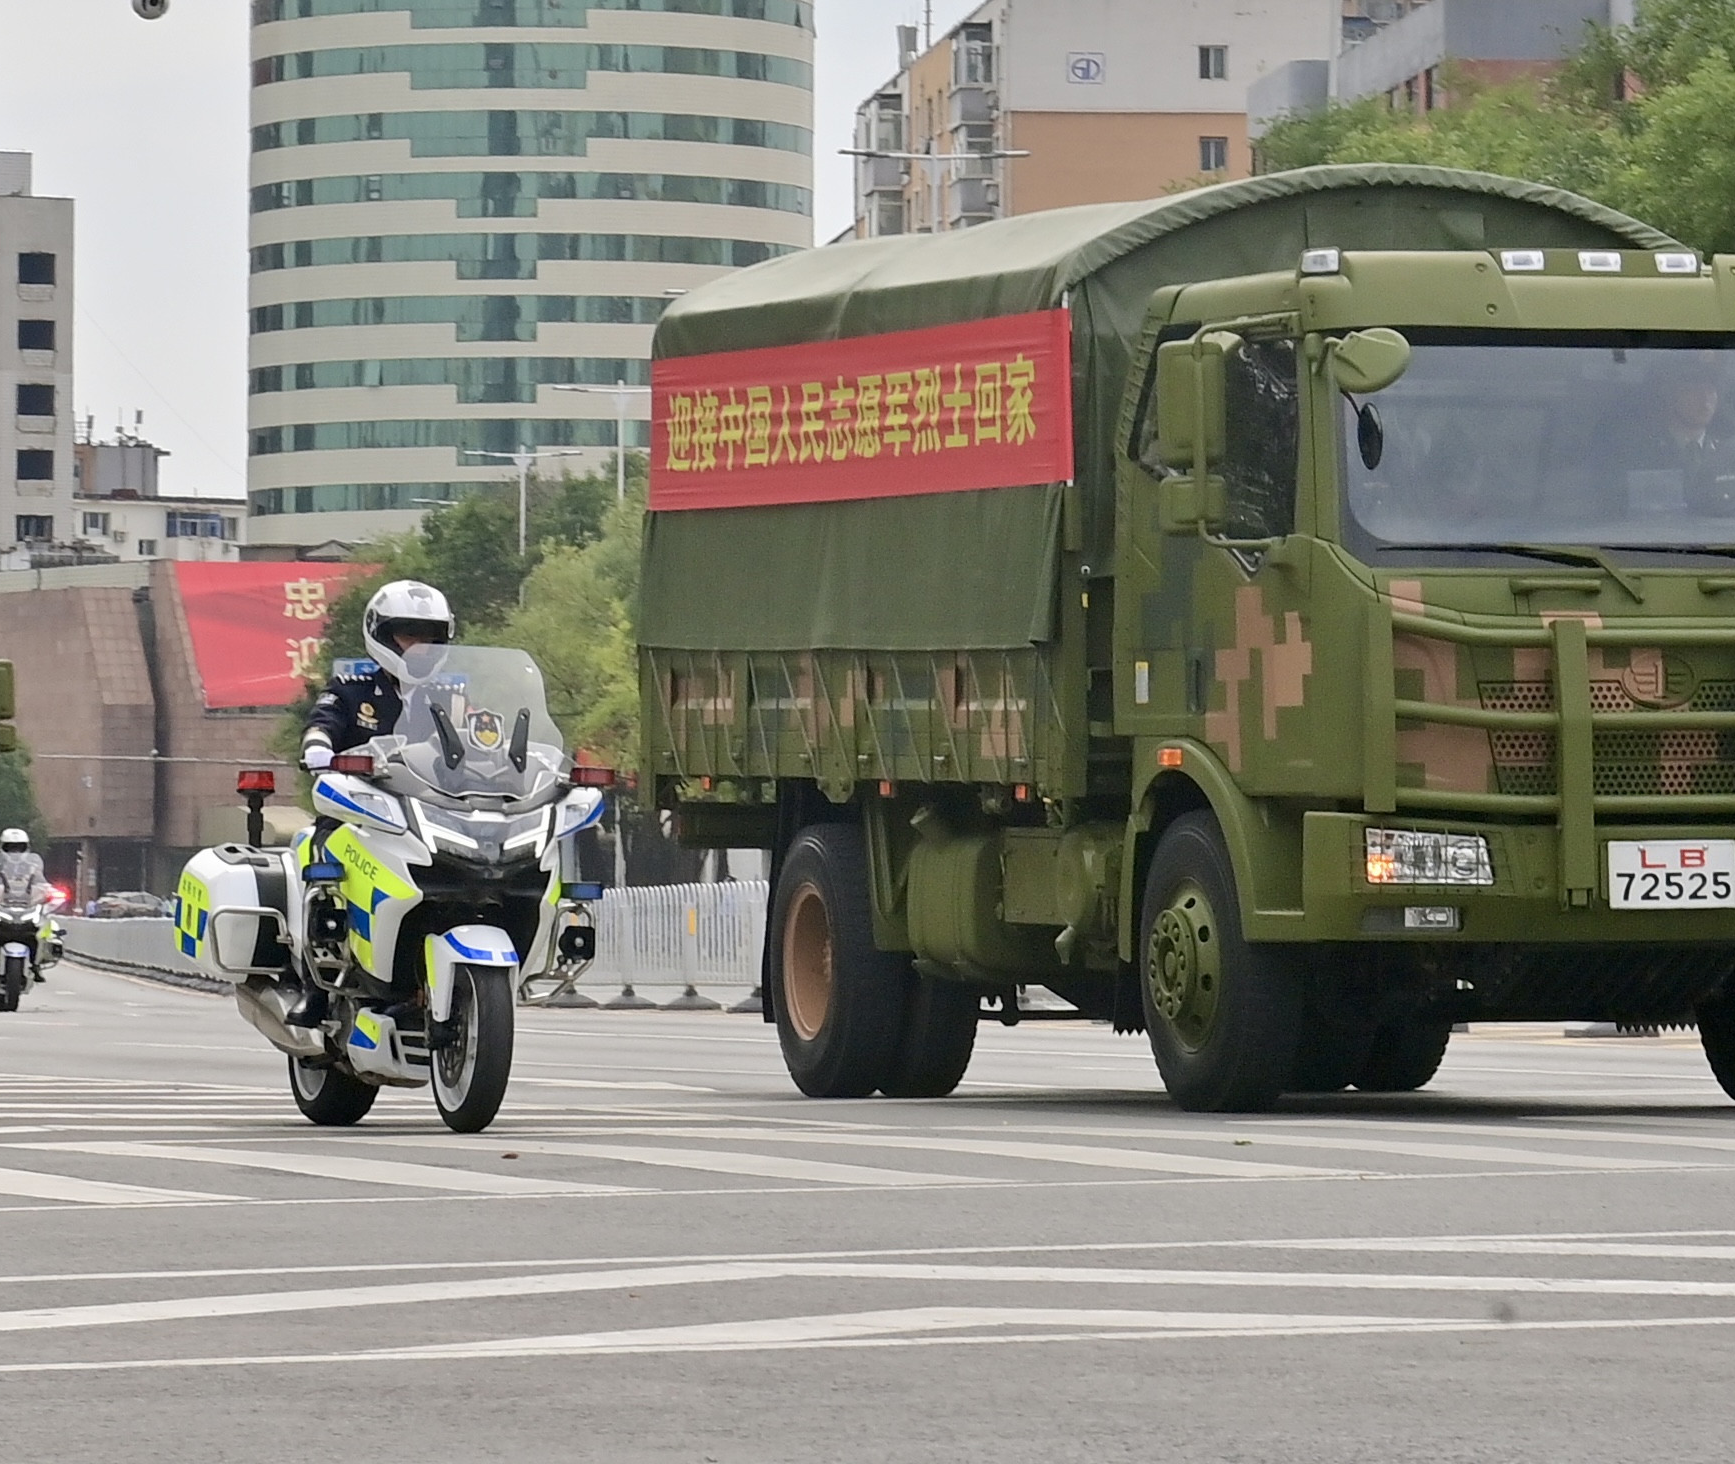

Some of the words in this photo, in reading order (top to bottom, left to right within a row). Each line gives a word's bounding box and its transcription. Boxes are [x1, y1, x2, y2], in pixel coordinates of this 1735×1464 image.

[666, 353, 1036, 472] 迎接中国人民志愿军烈士回家
[344, 843, 379, 881] POLICE
[1615, 871, 1732, 902] 72525
